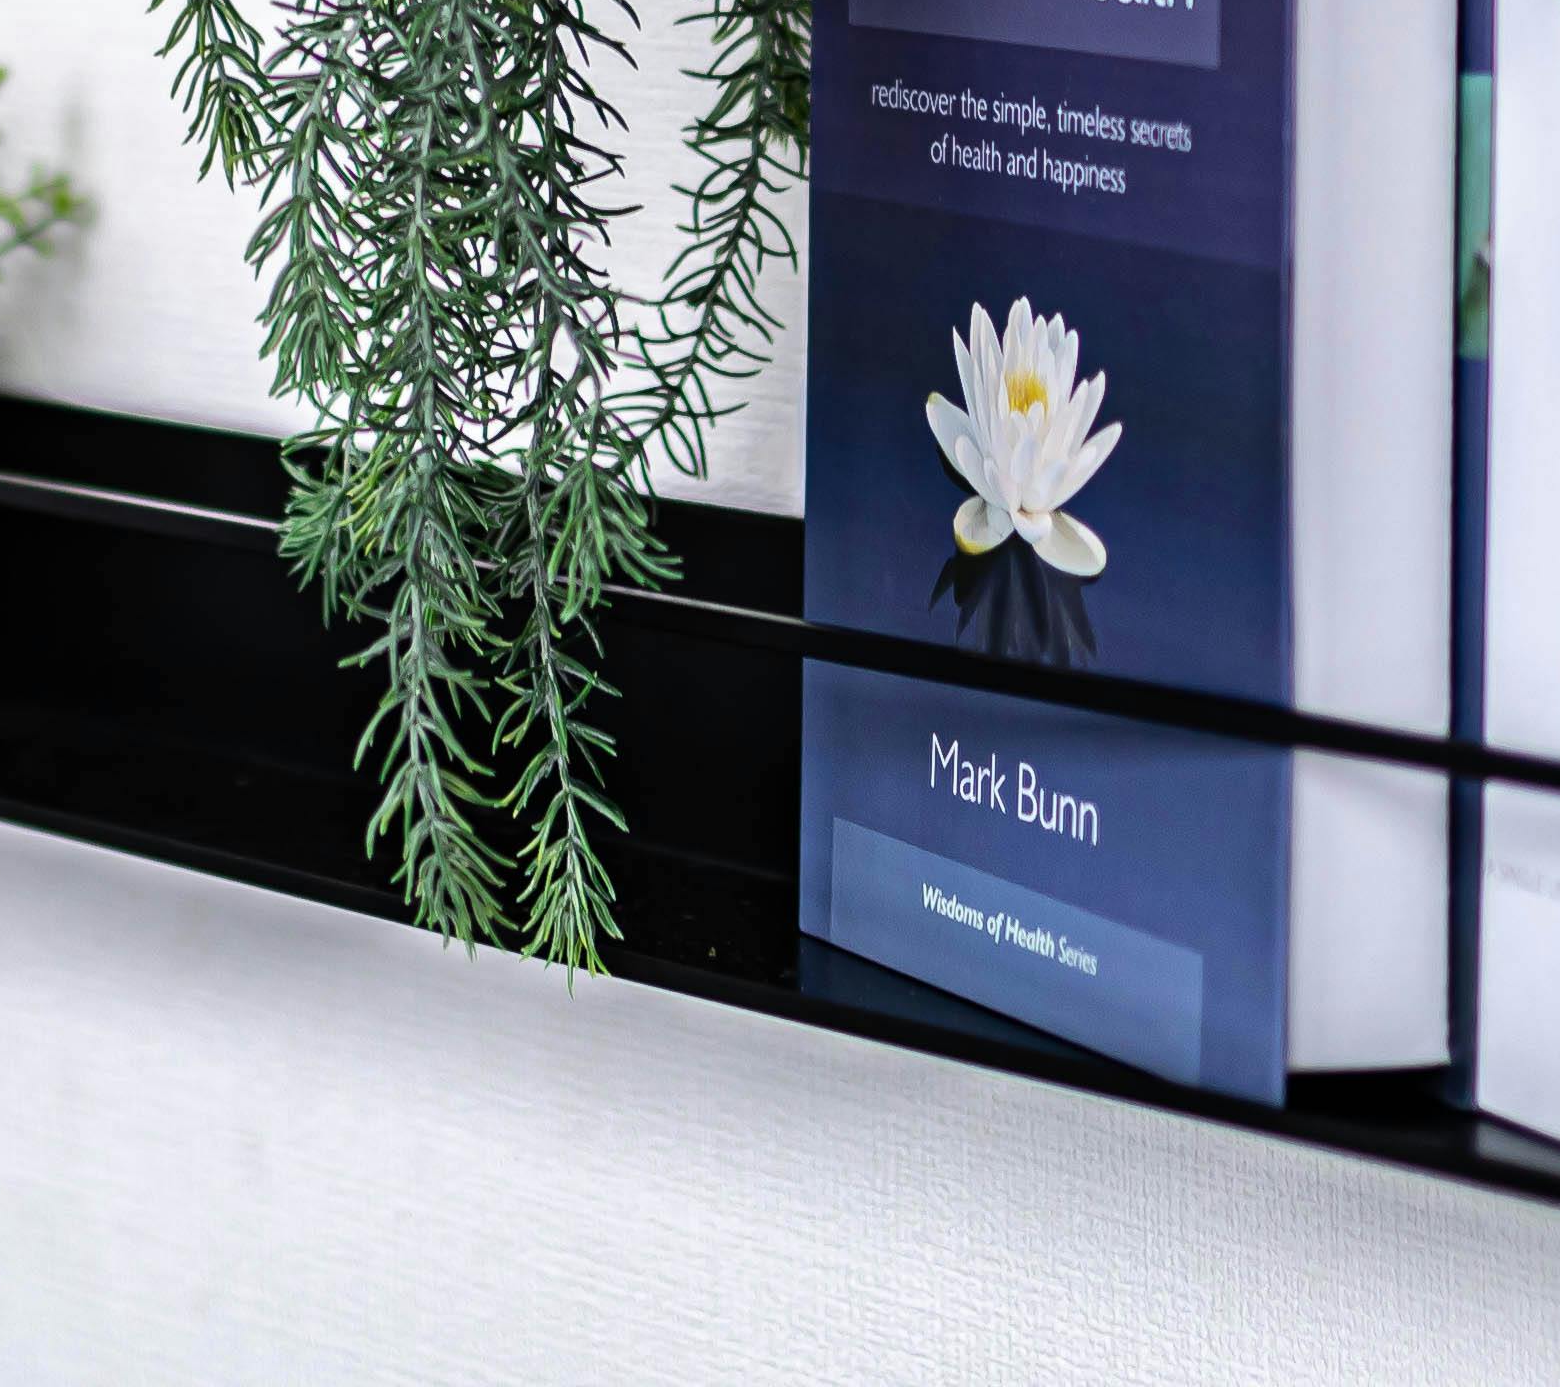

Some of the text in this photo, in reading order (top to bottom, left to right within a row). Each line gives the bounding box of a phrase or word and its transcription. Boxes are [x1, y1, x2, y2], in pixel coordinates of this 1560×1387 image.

[871, 78, 1193, 153] rediscover the simple, timeless secrets
[929, 132, 1127, 196] of health and happiness
[929, 732, 1100, 847] Mark Bunn
[922, 882, 1098, 976] Wisdoms of Health Series
